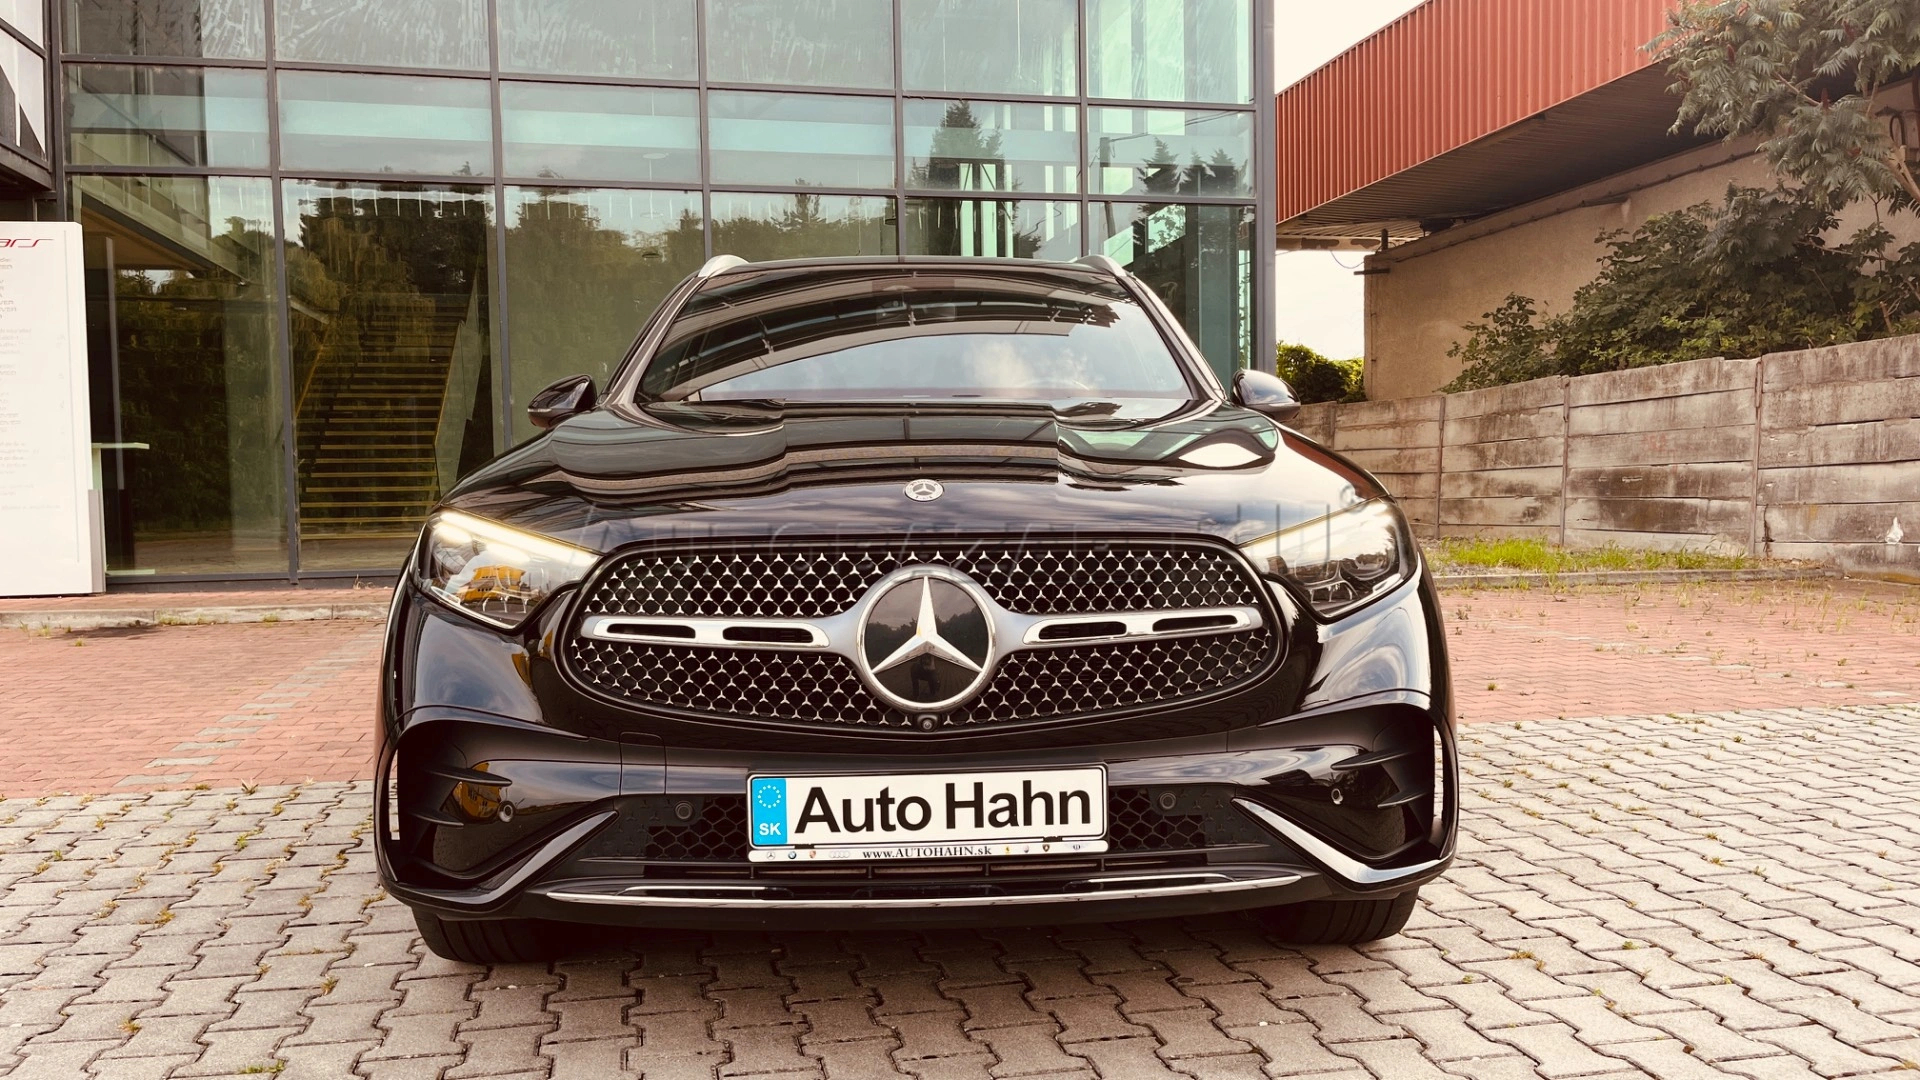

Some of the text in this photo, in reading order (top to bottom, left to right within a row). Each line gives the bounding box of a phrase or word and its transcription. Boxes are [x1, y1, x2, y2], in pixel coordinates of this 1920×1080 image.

[795, 780, 1092, 834] Auto Hahn
[758, 822, 782, 837] SK
[862, 846, 992, 859] www.AUTOHAHN.sk
